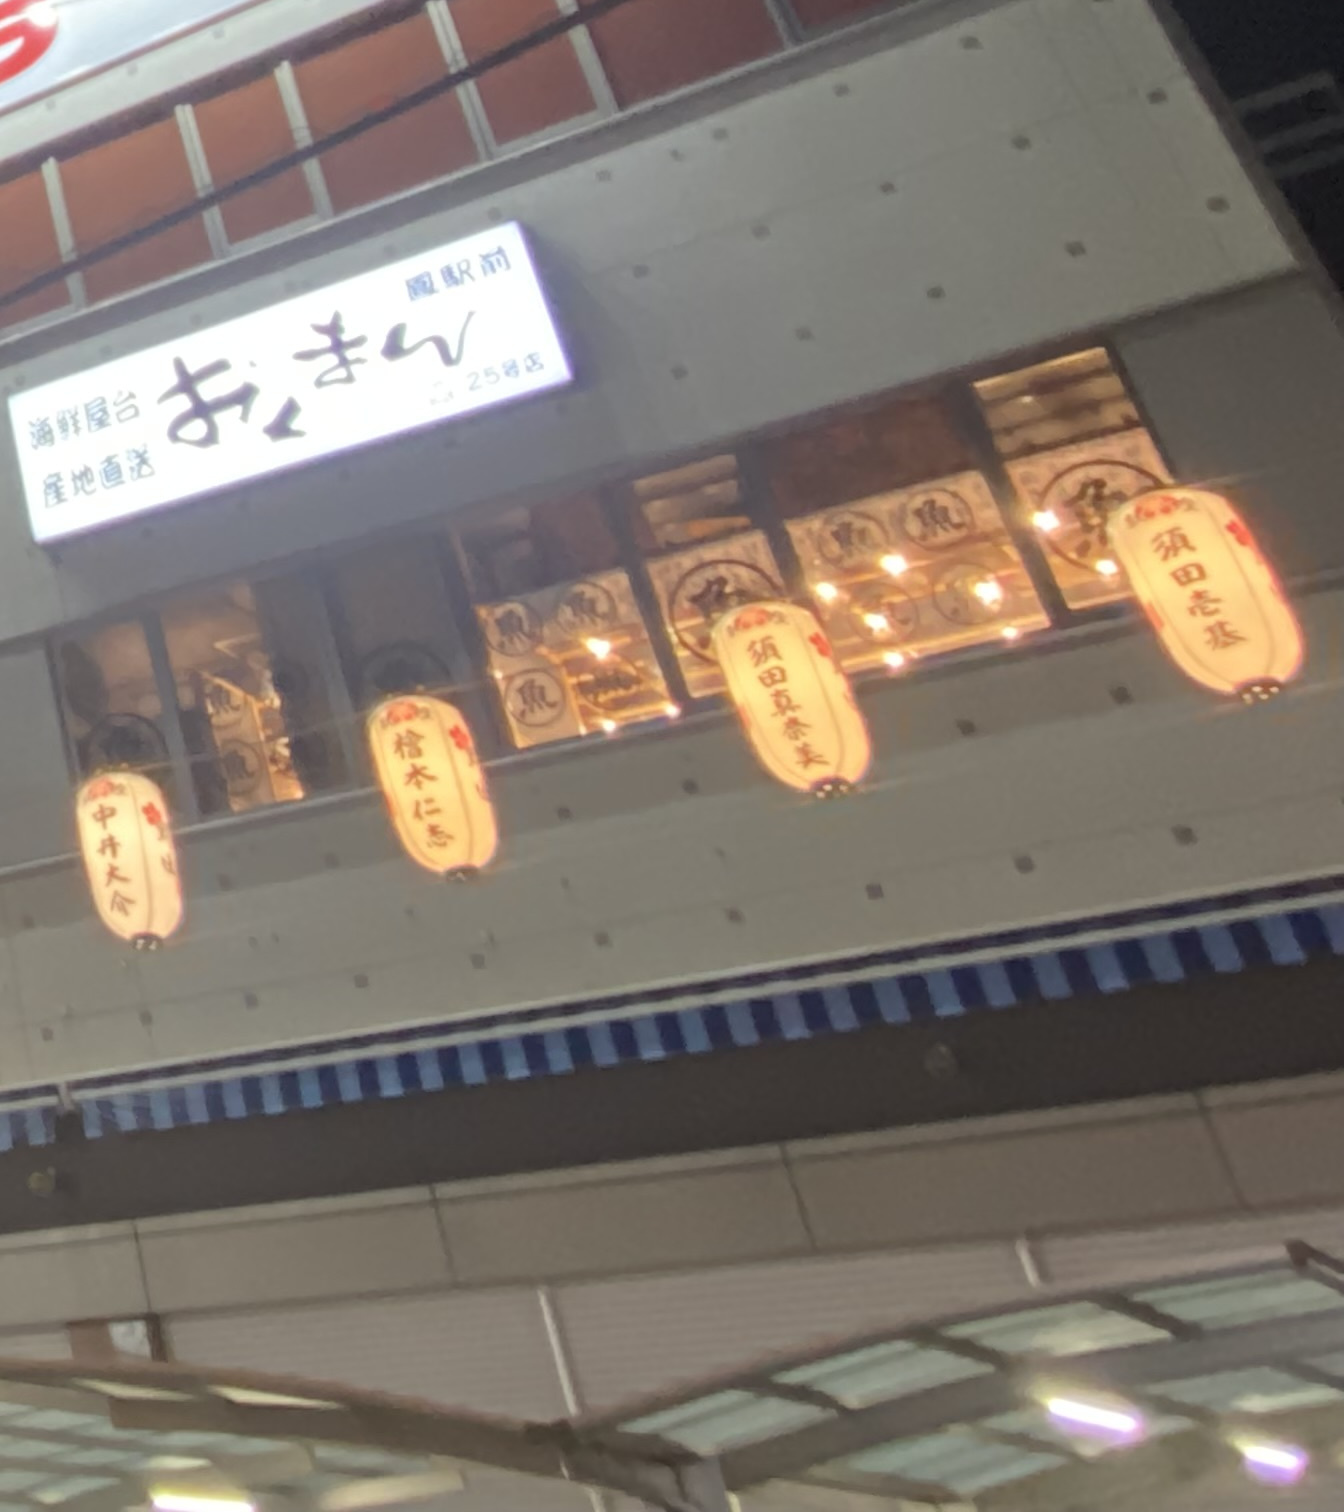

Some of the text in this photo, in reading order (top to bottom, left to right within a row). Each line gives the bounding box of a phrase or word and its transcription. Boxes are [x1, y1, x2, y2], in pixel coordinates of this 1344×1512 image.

[27, 389, 141, 451] 海鮮屋台
[42, 442, 156, 509] 産地直送
